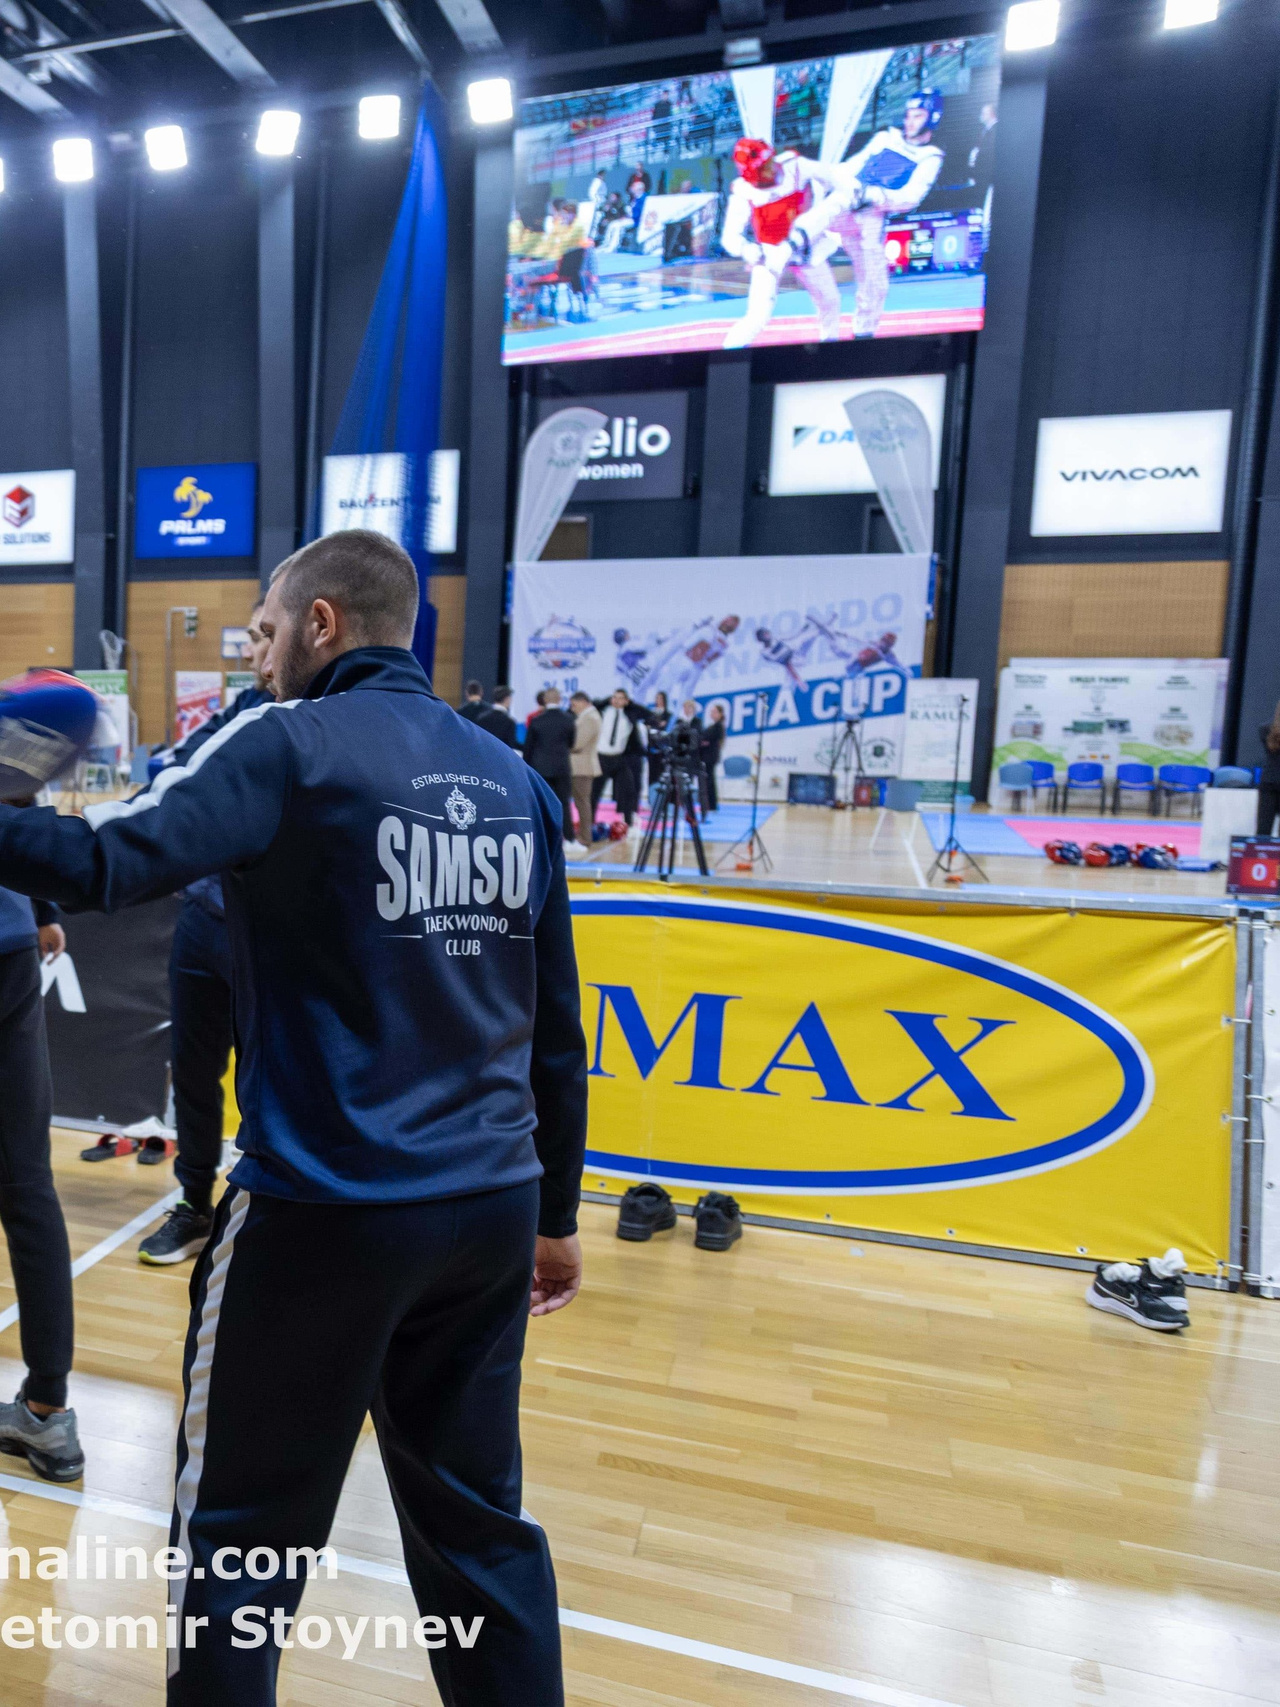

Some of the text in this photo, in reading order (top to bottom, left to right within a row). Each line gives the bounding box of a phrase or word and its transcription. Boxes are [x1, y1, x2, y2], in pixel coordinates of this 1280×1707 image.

[586, 416, 671, 459] elio
[577, 462, 644, 480] women
[1059, 465, 1200, 482] VIVACOM
[811, 671, 903, 721] CUP
[910, 709, 971, 721] RAMUS
[411, 772, 508, 797] ESTABLISHED 2015
[424, 914, 508, 934] TAEKWONDO
[445, 939, 481, 956] CLUB
